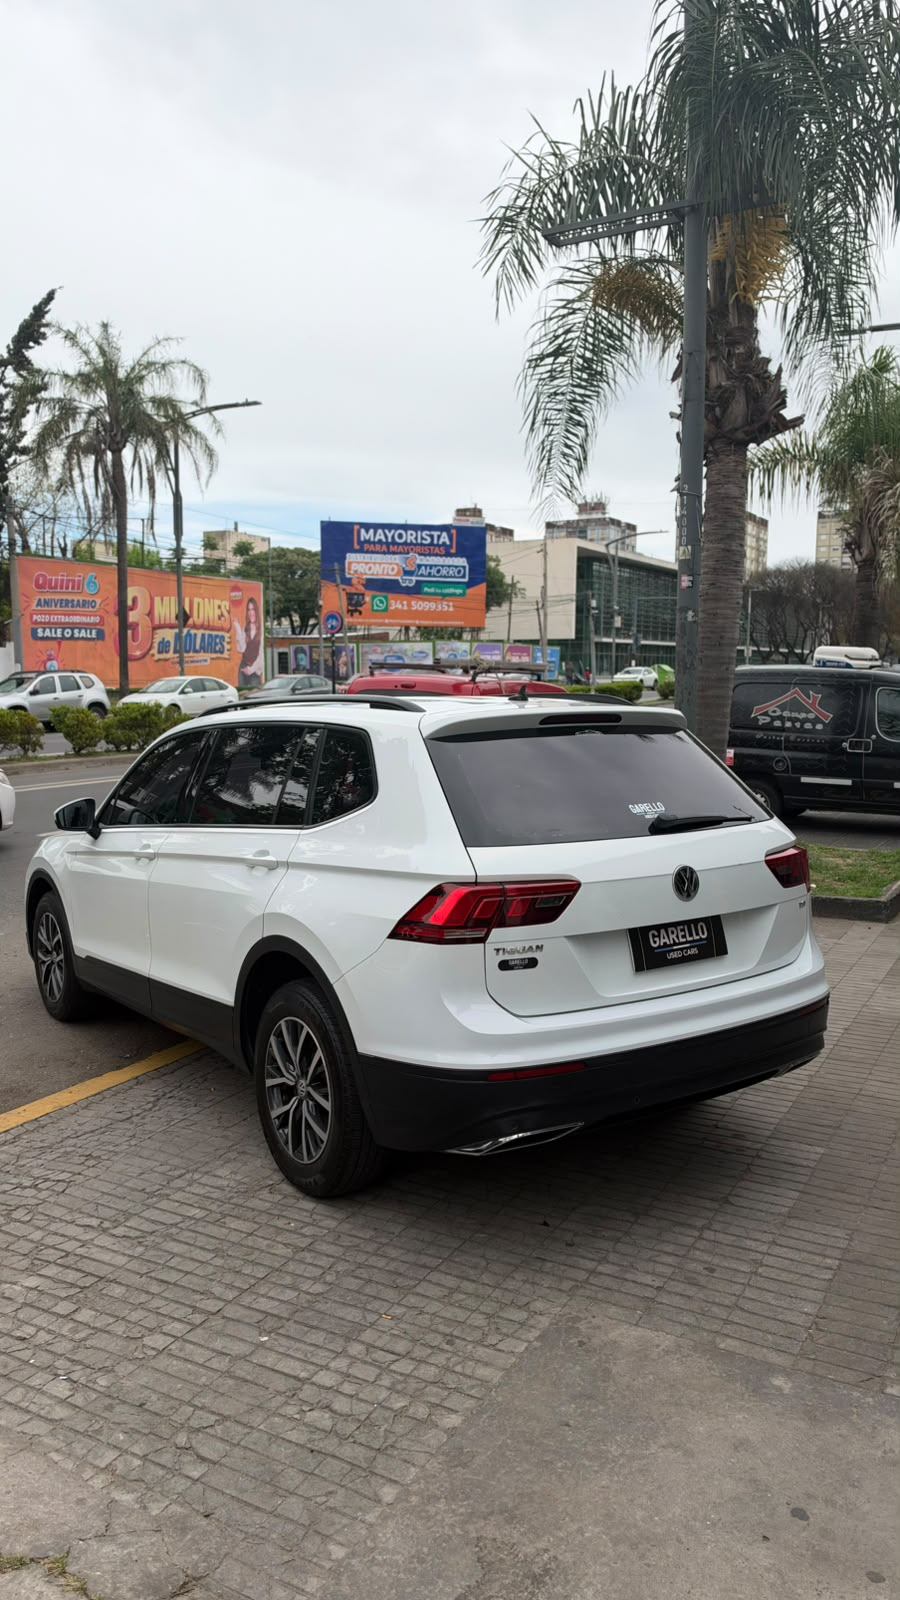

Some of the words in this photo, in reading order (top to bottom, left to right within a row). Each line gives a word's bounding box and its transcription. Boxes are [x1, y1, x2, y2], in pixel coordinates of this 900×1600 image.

[364, 544, 387, 552] PARA
[390, 545, 445, 554] MAYORISTAS
[351, 564, 398, 575] PRONTO
[418, 566, 464, 577] AHORRO
[34, 573, 82, 592] Quini
[85, 574, 99, 594] 6
[36, 598, 97, 609] ANIVERSARIO
[390, 602, 410, 611] 341
[412, 603, 454, 612] 5099351
[51, 615, 100, 623] EXTRAORDINARIO
[122, 586, 152, 656] 3
[37, 628, 62, 637] SALE
[64, 629, 72, 637] O
[73, 629, 97, 638] SALE
[157, 638, 170, 655] de
[628, 801, 665, 814] GARELLO
[649, 922, 708, 948] GARELLO
[667, 950, 683, 959] USED
[684, 948, 698, 957] CARS
